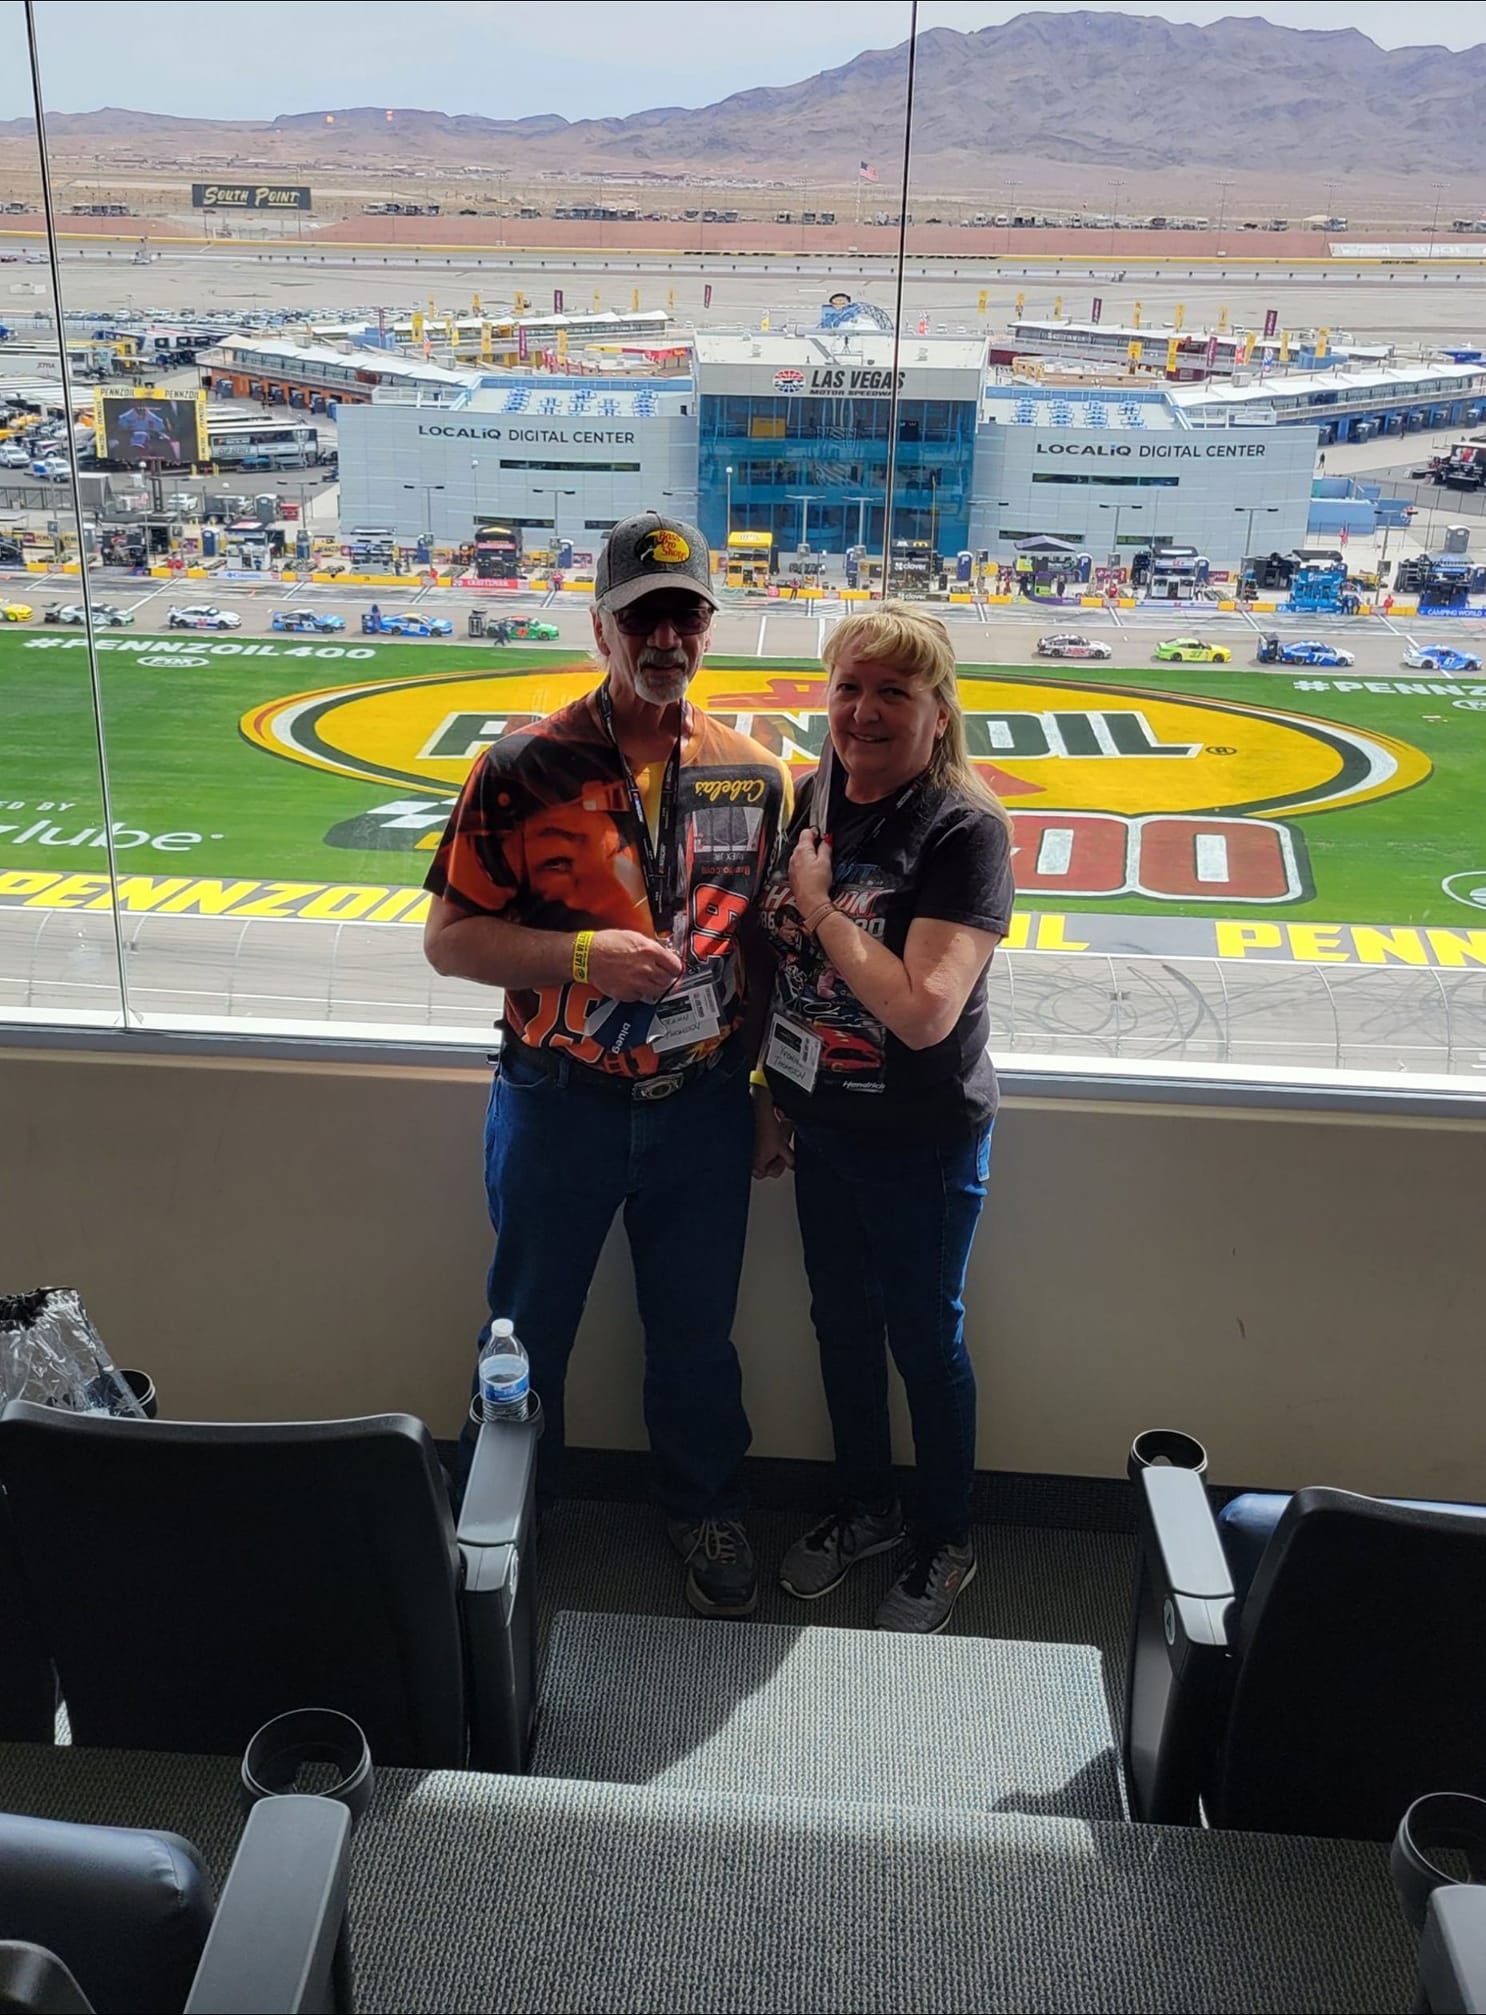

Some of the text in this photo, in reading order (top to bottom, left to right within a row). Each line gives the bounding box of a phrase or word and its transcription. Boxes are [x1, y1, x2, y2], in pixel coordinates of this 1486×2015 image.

[203, 186, 300, 207] SOUTH POINT
[811, 370, 905, 389] LAS VEGAS
[508, 429, 568, 443] DIGITAL
[573, 431, 635, 444] CENTER
[1138, 445, 1202, 458] DIGITAL
[1206, 443, 1266, 458] CENTER
[657, 530, 681, 543] Bass
[661, 541, 677, 549] Pro
[903, 562, 926, 570] clover
[1428, 608, 1482, 617] CAMPING WORLD
[23, 636, 377, 660] #PENNZOIL400
[1293, 680, 1486, 696] #PENNZ
[695, 778, 765, 802] Cabela's
[35, 801, 77, 812] BY
[0, 820, 204, 852] lube
[0, 871, 433, 923] PENNZOI
[1214, 921, 1486, 967] PENN
[611, 1022, 631, 1055] blueg
[843, 1080, 886, 1090] Hendrick
